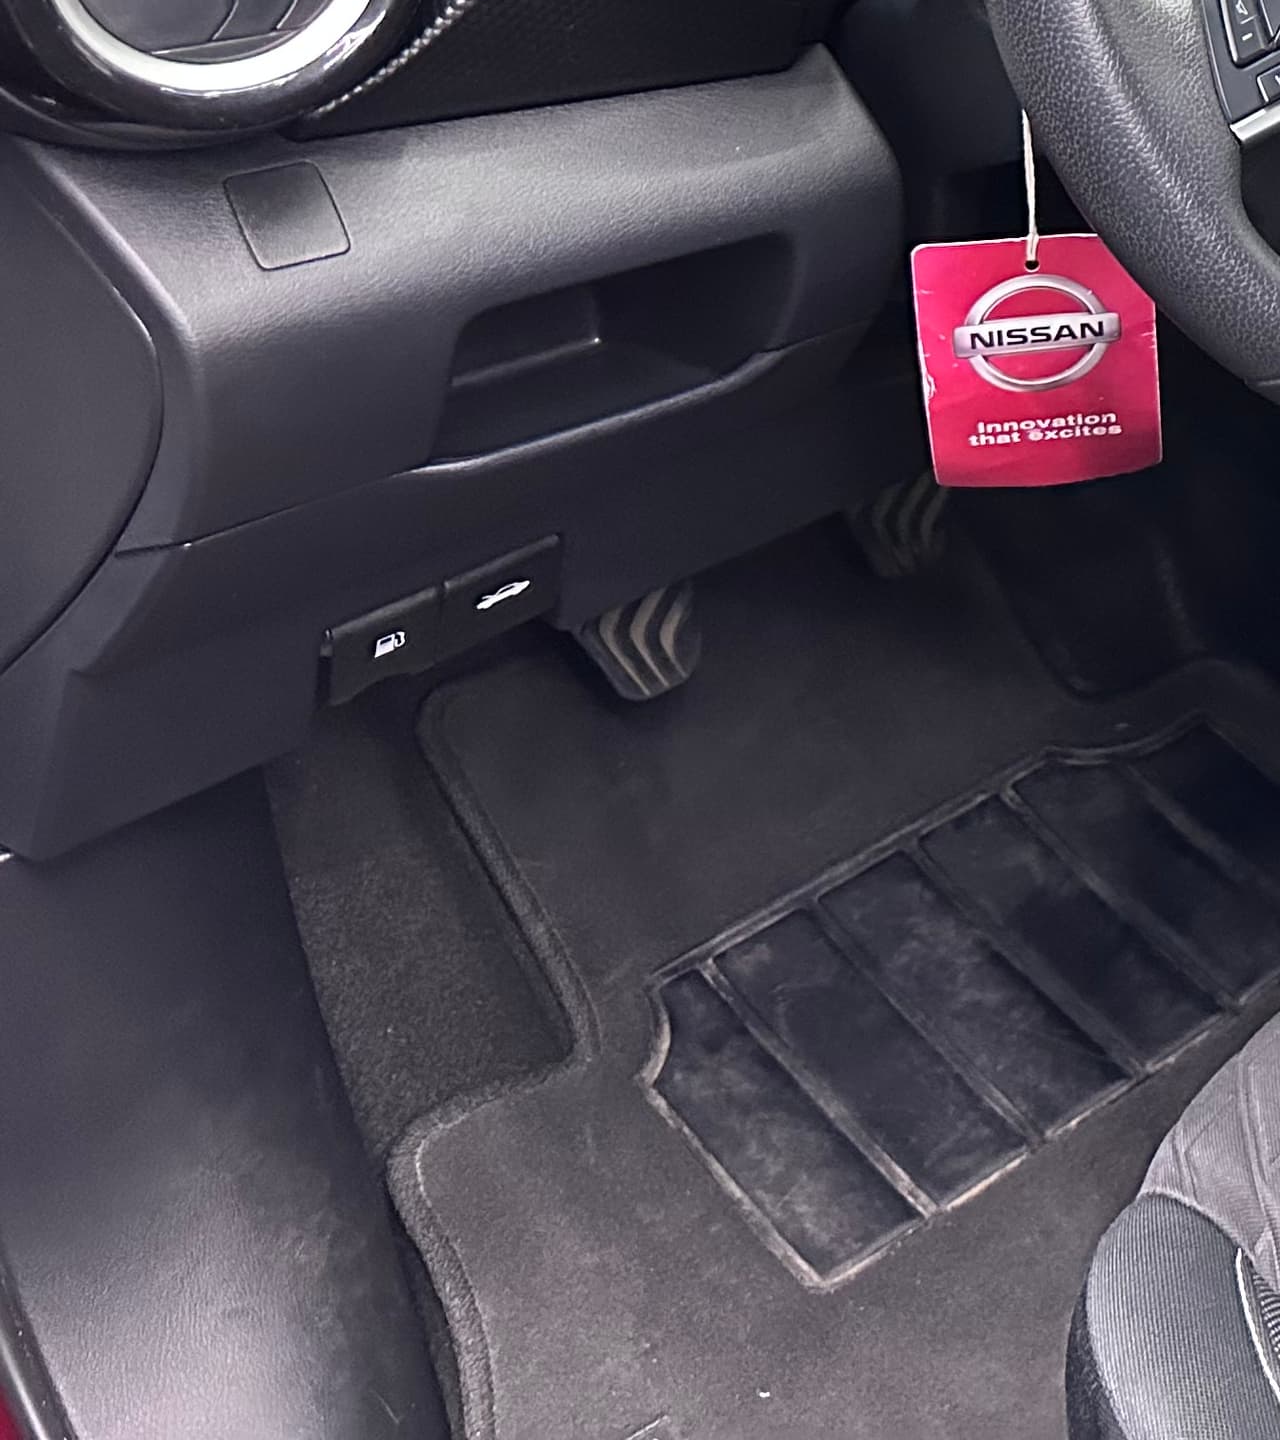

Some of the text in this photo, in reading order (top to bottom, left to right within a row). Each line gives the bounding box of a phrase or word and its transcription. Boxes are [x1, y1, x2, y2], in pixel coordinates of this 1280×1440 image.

[969, 320, 1105, 350] NISSAN
[976, 411, 1117, 434] Innovation
[968, 423, 1123, 447] that excites
